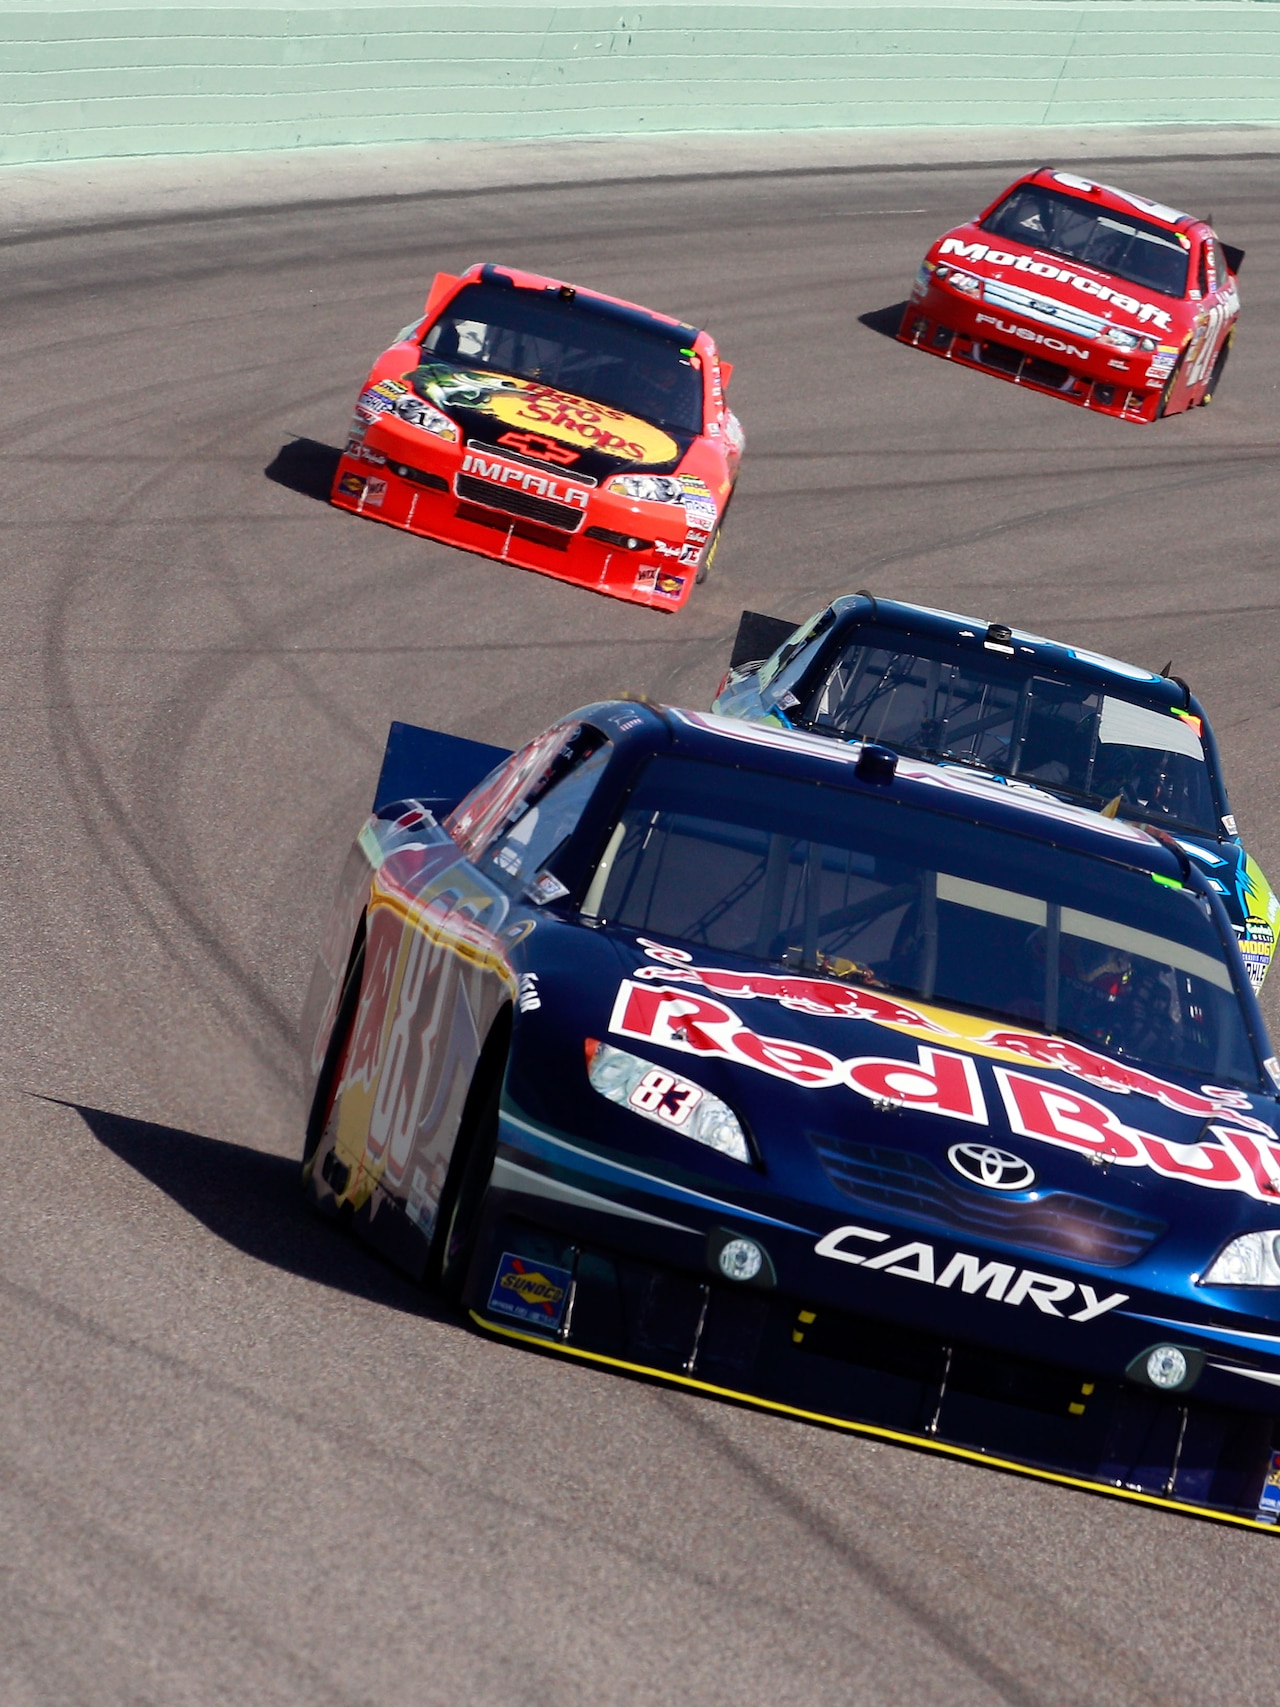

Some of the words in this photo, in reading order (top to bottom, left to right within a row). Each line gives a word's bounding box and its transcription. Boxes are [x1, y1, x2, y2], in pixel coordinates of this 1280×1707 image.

[938, 238, 1173, 332] Motorcraft
[976, 313, 1090, 360] FUSION
[521, 383, 625, 421] Bass
[524, 390, 602, 423] Pro
[517, 403, 648, 460] Shops
[461, 455, 590, 508] IMPALA
[1238, 940, 1270, 956] MOOG
[607, 979, 989, 1126] Red
[628, 1068, 705, 1127] 83
[502, 1274, 563, 1301] SUNOCO
[814, 1225, 1131, 1322] CAMRY
